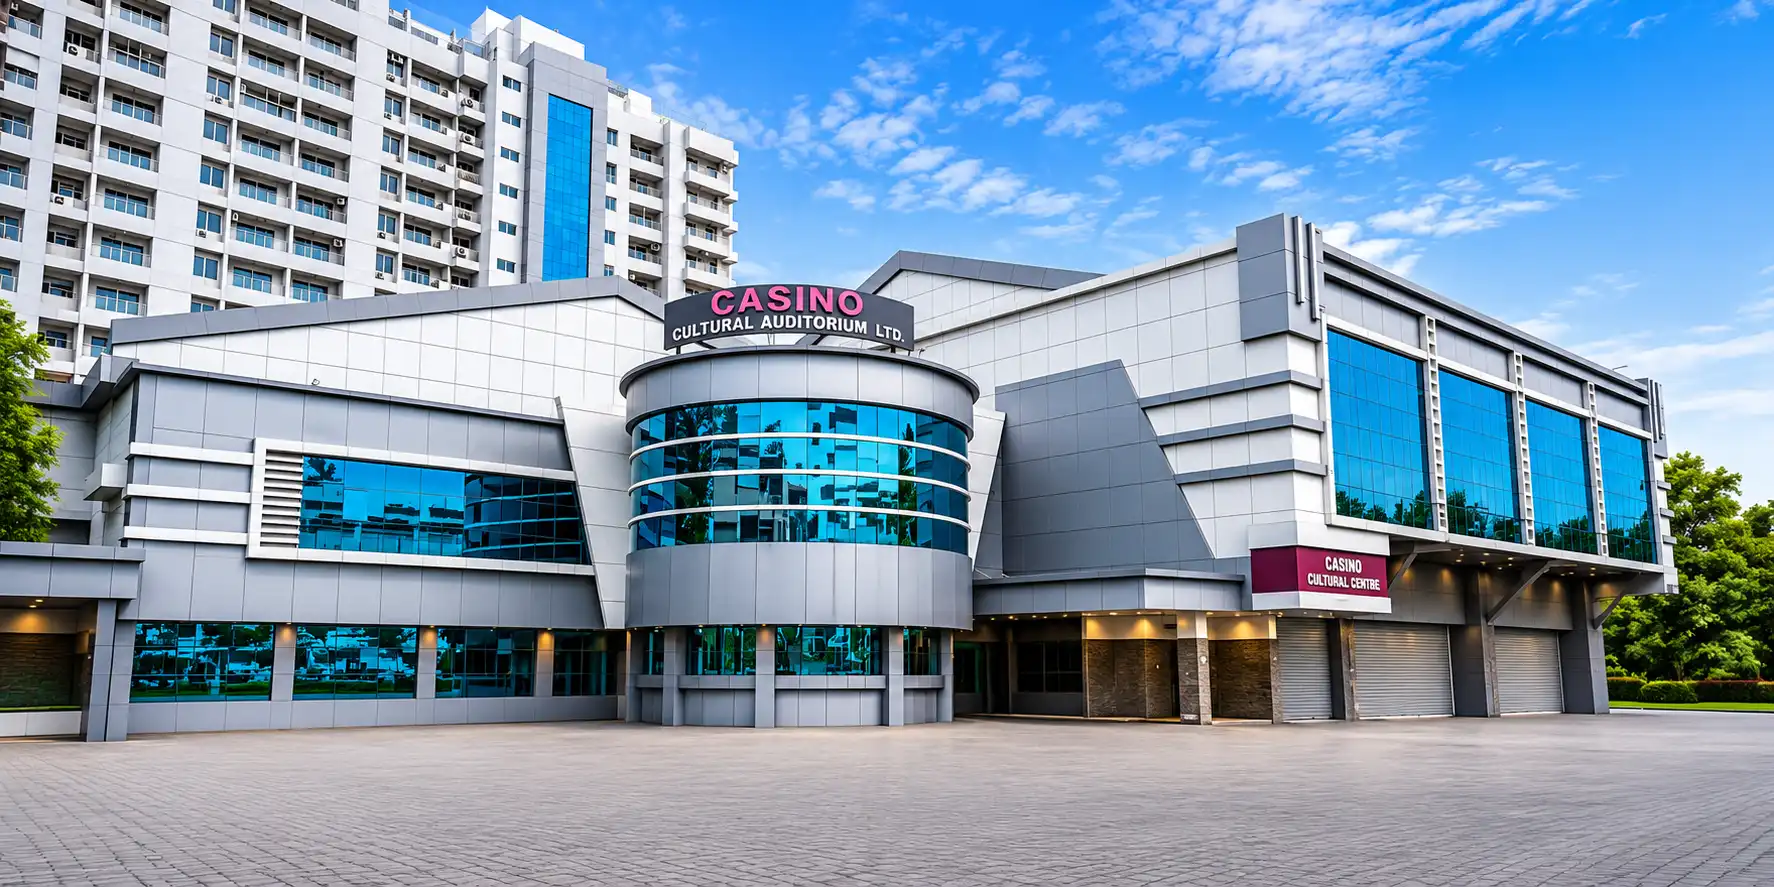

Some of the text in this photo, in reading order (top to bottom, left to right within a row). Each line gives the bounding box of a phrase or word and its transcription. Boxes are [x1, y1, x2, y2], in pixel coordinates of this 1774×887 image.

[711, 286, 864, 316] CASINO
[672, 315, 905, 343] CULTURAL AUDITORIUM LTD.
[1325, 556, 1362, 574] CASINO
[1307, 573, 1350, 588] CULTURAL
